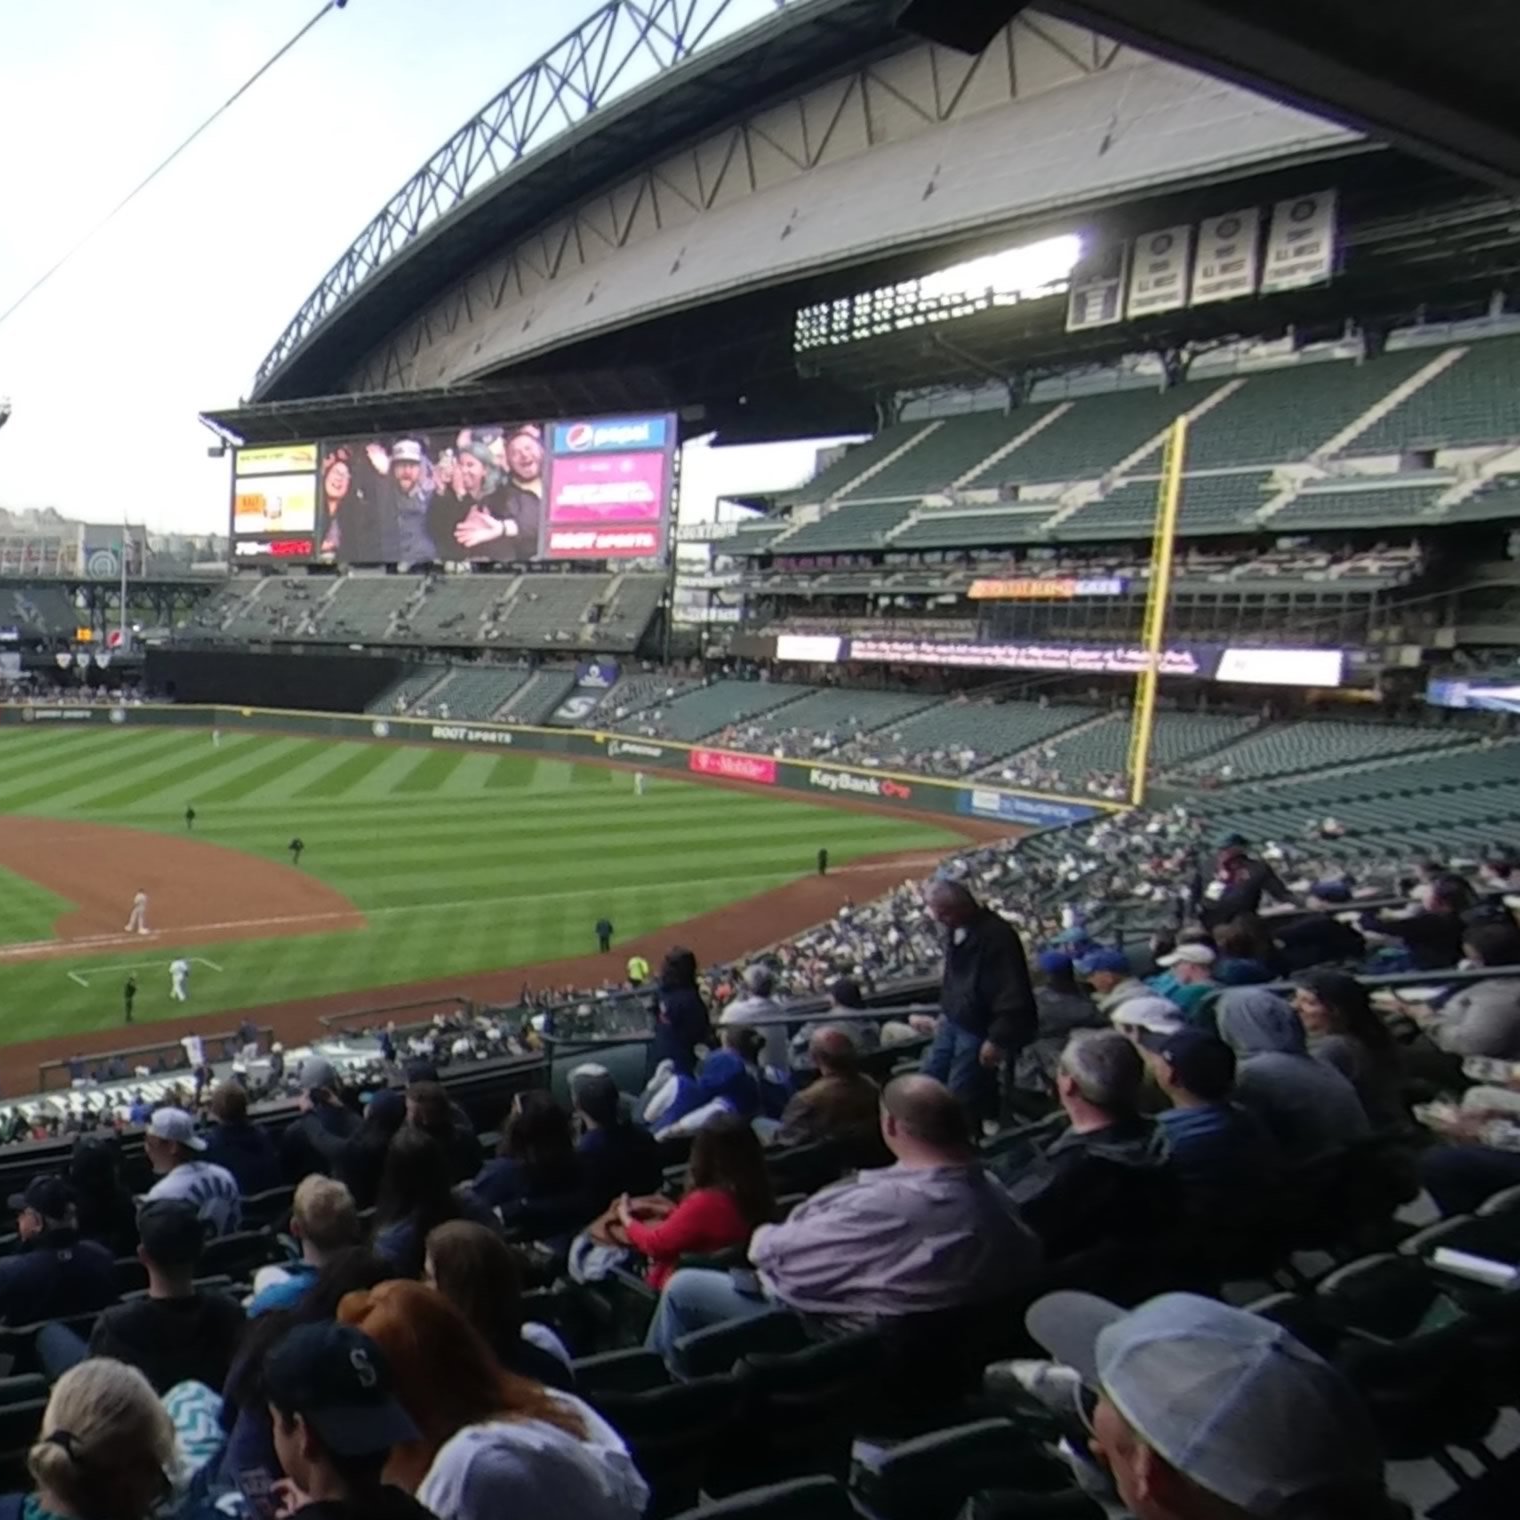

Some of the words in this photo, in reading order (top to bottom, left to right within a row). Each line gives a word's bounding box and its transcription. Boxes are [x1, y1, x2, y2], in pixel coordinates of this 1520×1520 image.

[431, 725, 468, 741] ROOT
[809, 768, 881, 796] KeyBank
[349, 1347, 377, 1388] S
